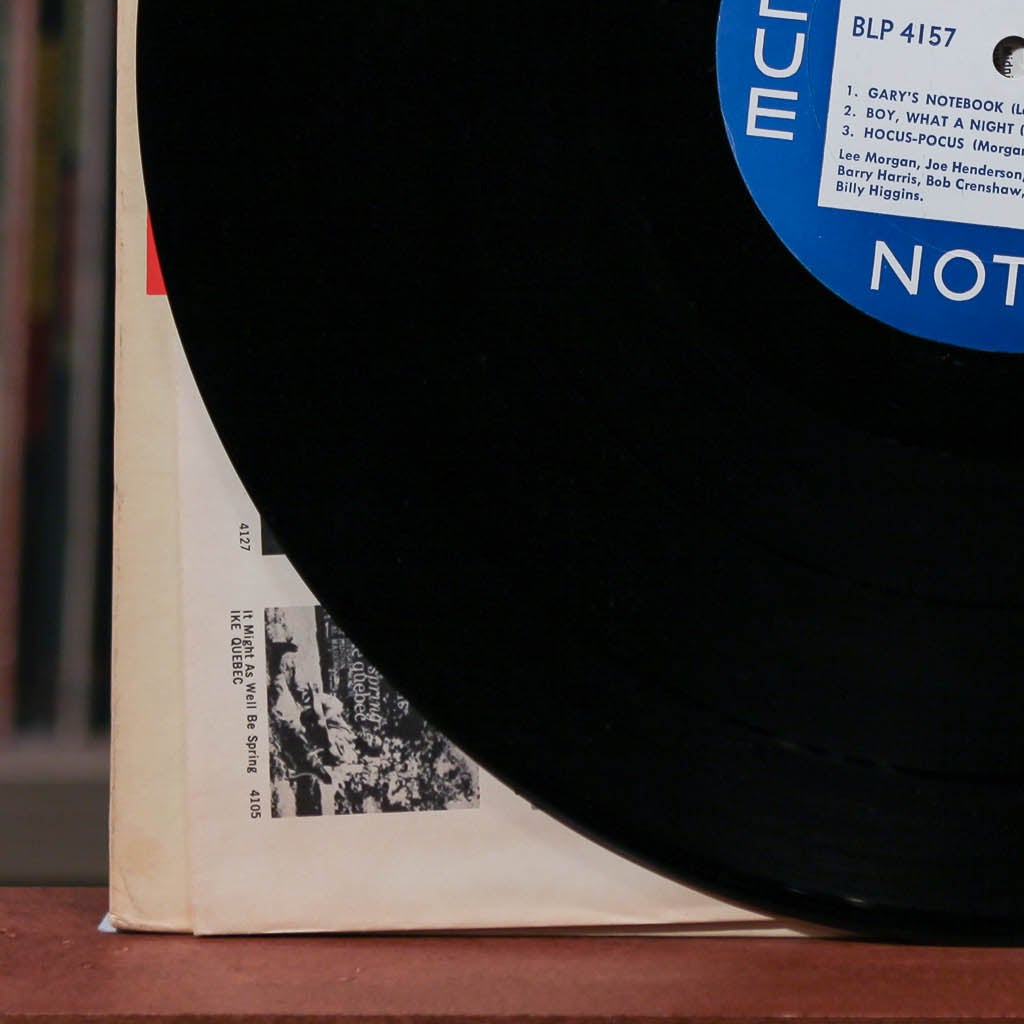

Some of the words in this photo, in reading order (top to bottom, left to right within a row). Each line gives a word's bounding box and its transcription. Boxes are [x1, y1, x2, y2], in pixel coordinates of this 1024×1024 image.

[852, 15, 894, 41] BLP
[899, 22, 957, 48] 4157
[868, 87, 919, 104] GARY'S
[925, 93, 1004, 114] NOTEBOOK
[844, 104, 856, 117] 2.
[866, 107, 899, 124] BOY,
[906, 111, 949, 127] WHAT
[953, 117, 964, 129] A
[969, 118, 1015, 135] NIGHT
[842, 125, 854, 137] 3.
[864, 127, 965, 150] HOCUS-POCUS
[839, 148, 861, 162] Lee
[864, 151, 921, 171] Morgan,
[924, 158, 948, 172] Joe
[836, 180, 865, 197] Billy
[869, 184, 924, 202] Higgins.
[837, 164, 874, 182] Barry
[877, 168, 921, 187] Harris,
[926, 174, 951, 188] Bob
[955, 178, 1024, 199] Crenshaw,
[239, 522, 251, 552] 4127
[230, 610, 241, 633] IKE
[243, 609, 253, 621] It
[243, 625, 256, 660] Might
[231, 637, 243, 685] QUEBEC
[244, 663, 254, 677] As
[246, 683, 258, 709] Well
[351, 661, 367, 722] quebec
[248, 714, 258, 730] Be
[247, 733, 260, 774] Spring
[250, 789, 262, 819] 4105
